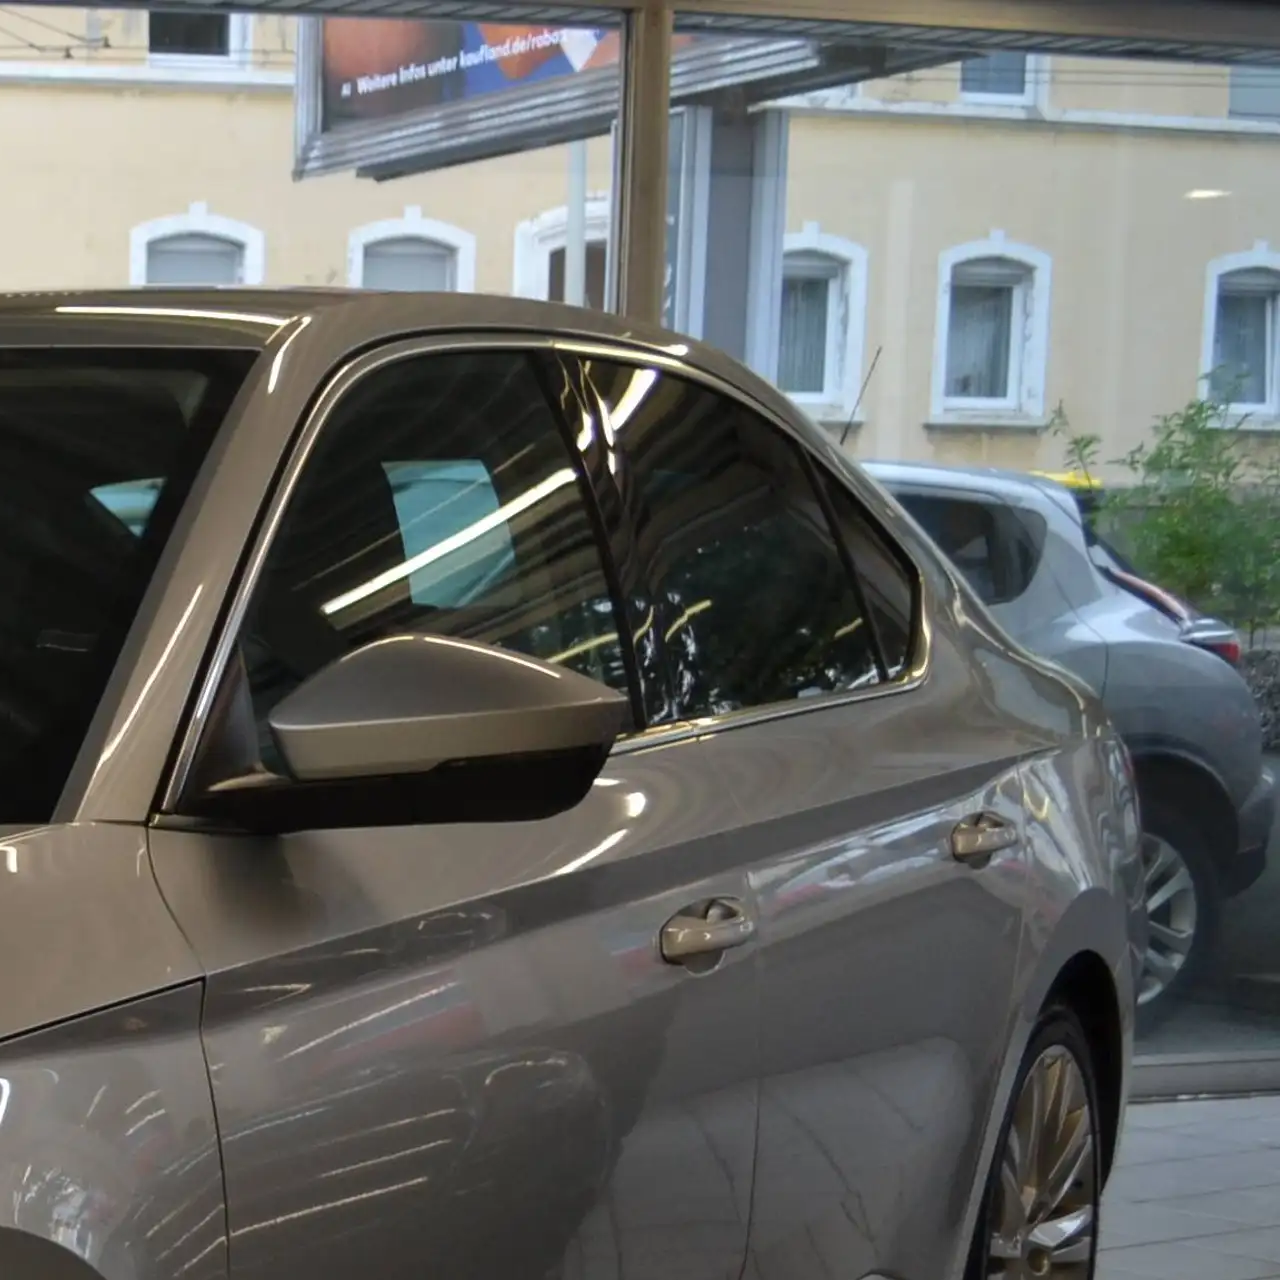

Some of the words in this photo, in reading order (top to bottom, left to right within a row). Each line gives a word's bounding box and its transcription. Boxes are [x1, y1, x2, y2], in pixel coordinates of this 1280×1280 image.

[356, 72, 398, 95] Weitere
[399, 62, 427, 85] Infos
[427, 56, 458, 77] unter
